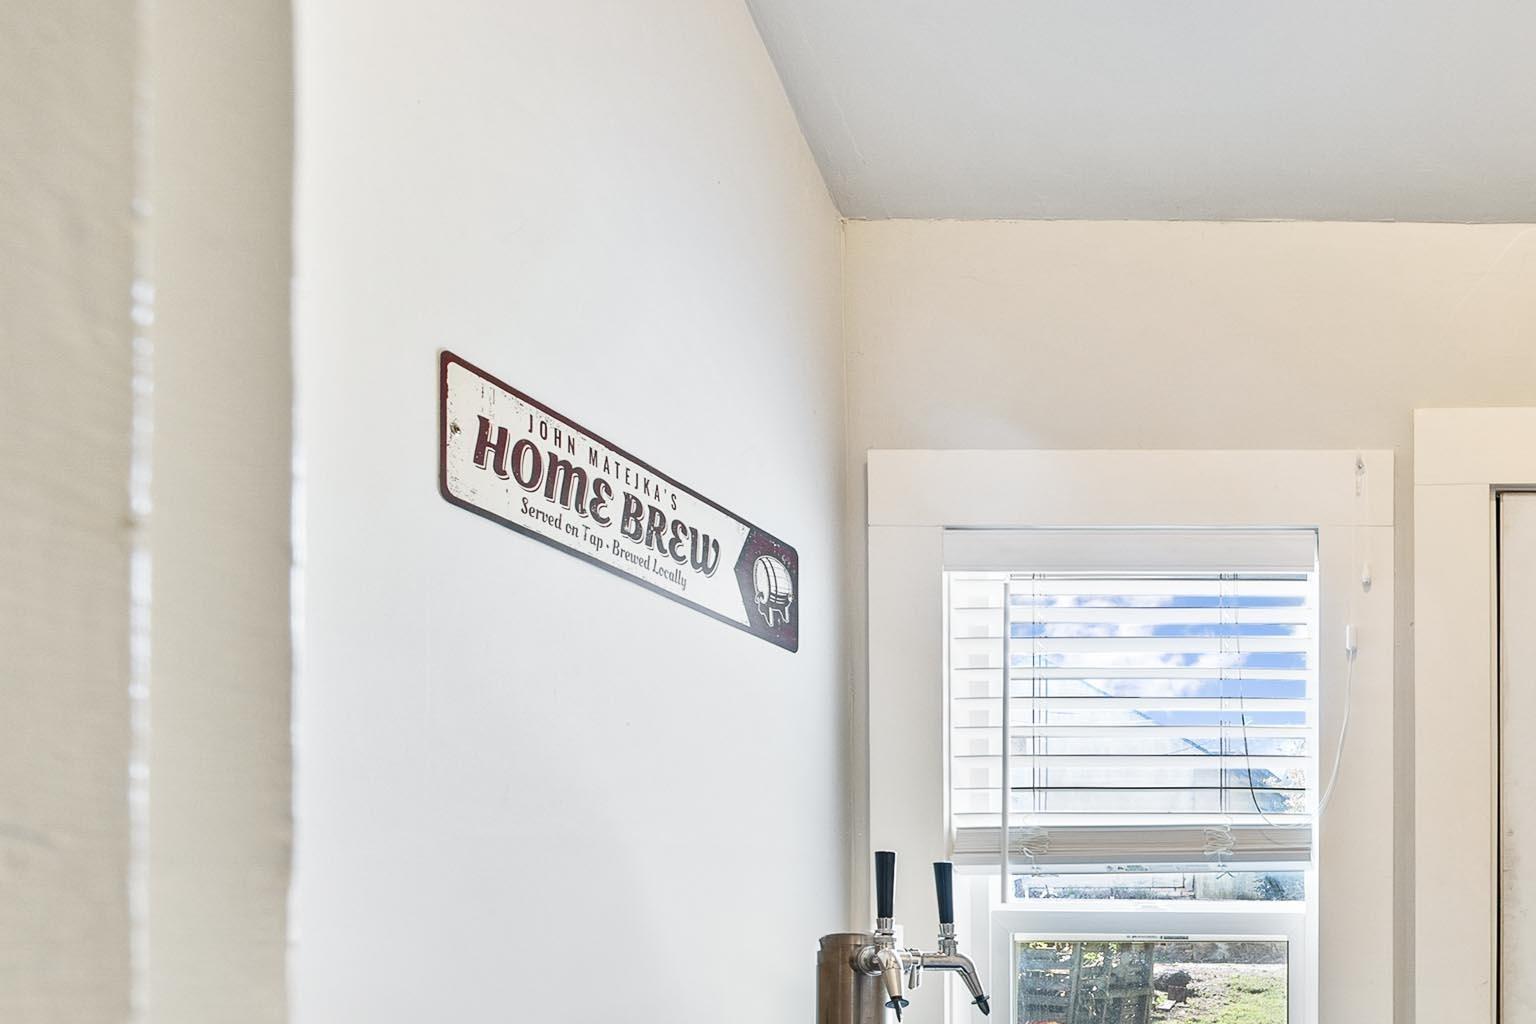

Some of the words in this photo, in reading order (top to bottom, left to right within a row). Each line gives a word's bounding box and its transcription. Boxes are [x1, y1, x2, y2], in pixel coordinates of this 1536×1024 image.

[473, 414, 615, 528] HOME
[620, 491, 721, 579] BREW
[528, 414, 576, 456] JOHN
[589, 447, 678, 511] MATEJKA'S
[520, 497, 562, 530] Served
[565, 522, 579, 537] on
[582, 524, 604, 551] Tap
[612, 539, 651, 571] Brewed
[652, 560, 688, 591] Locally
